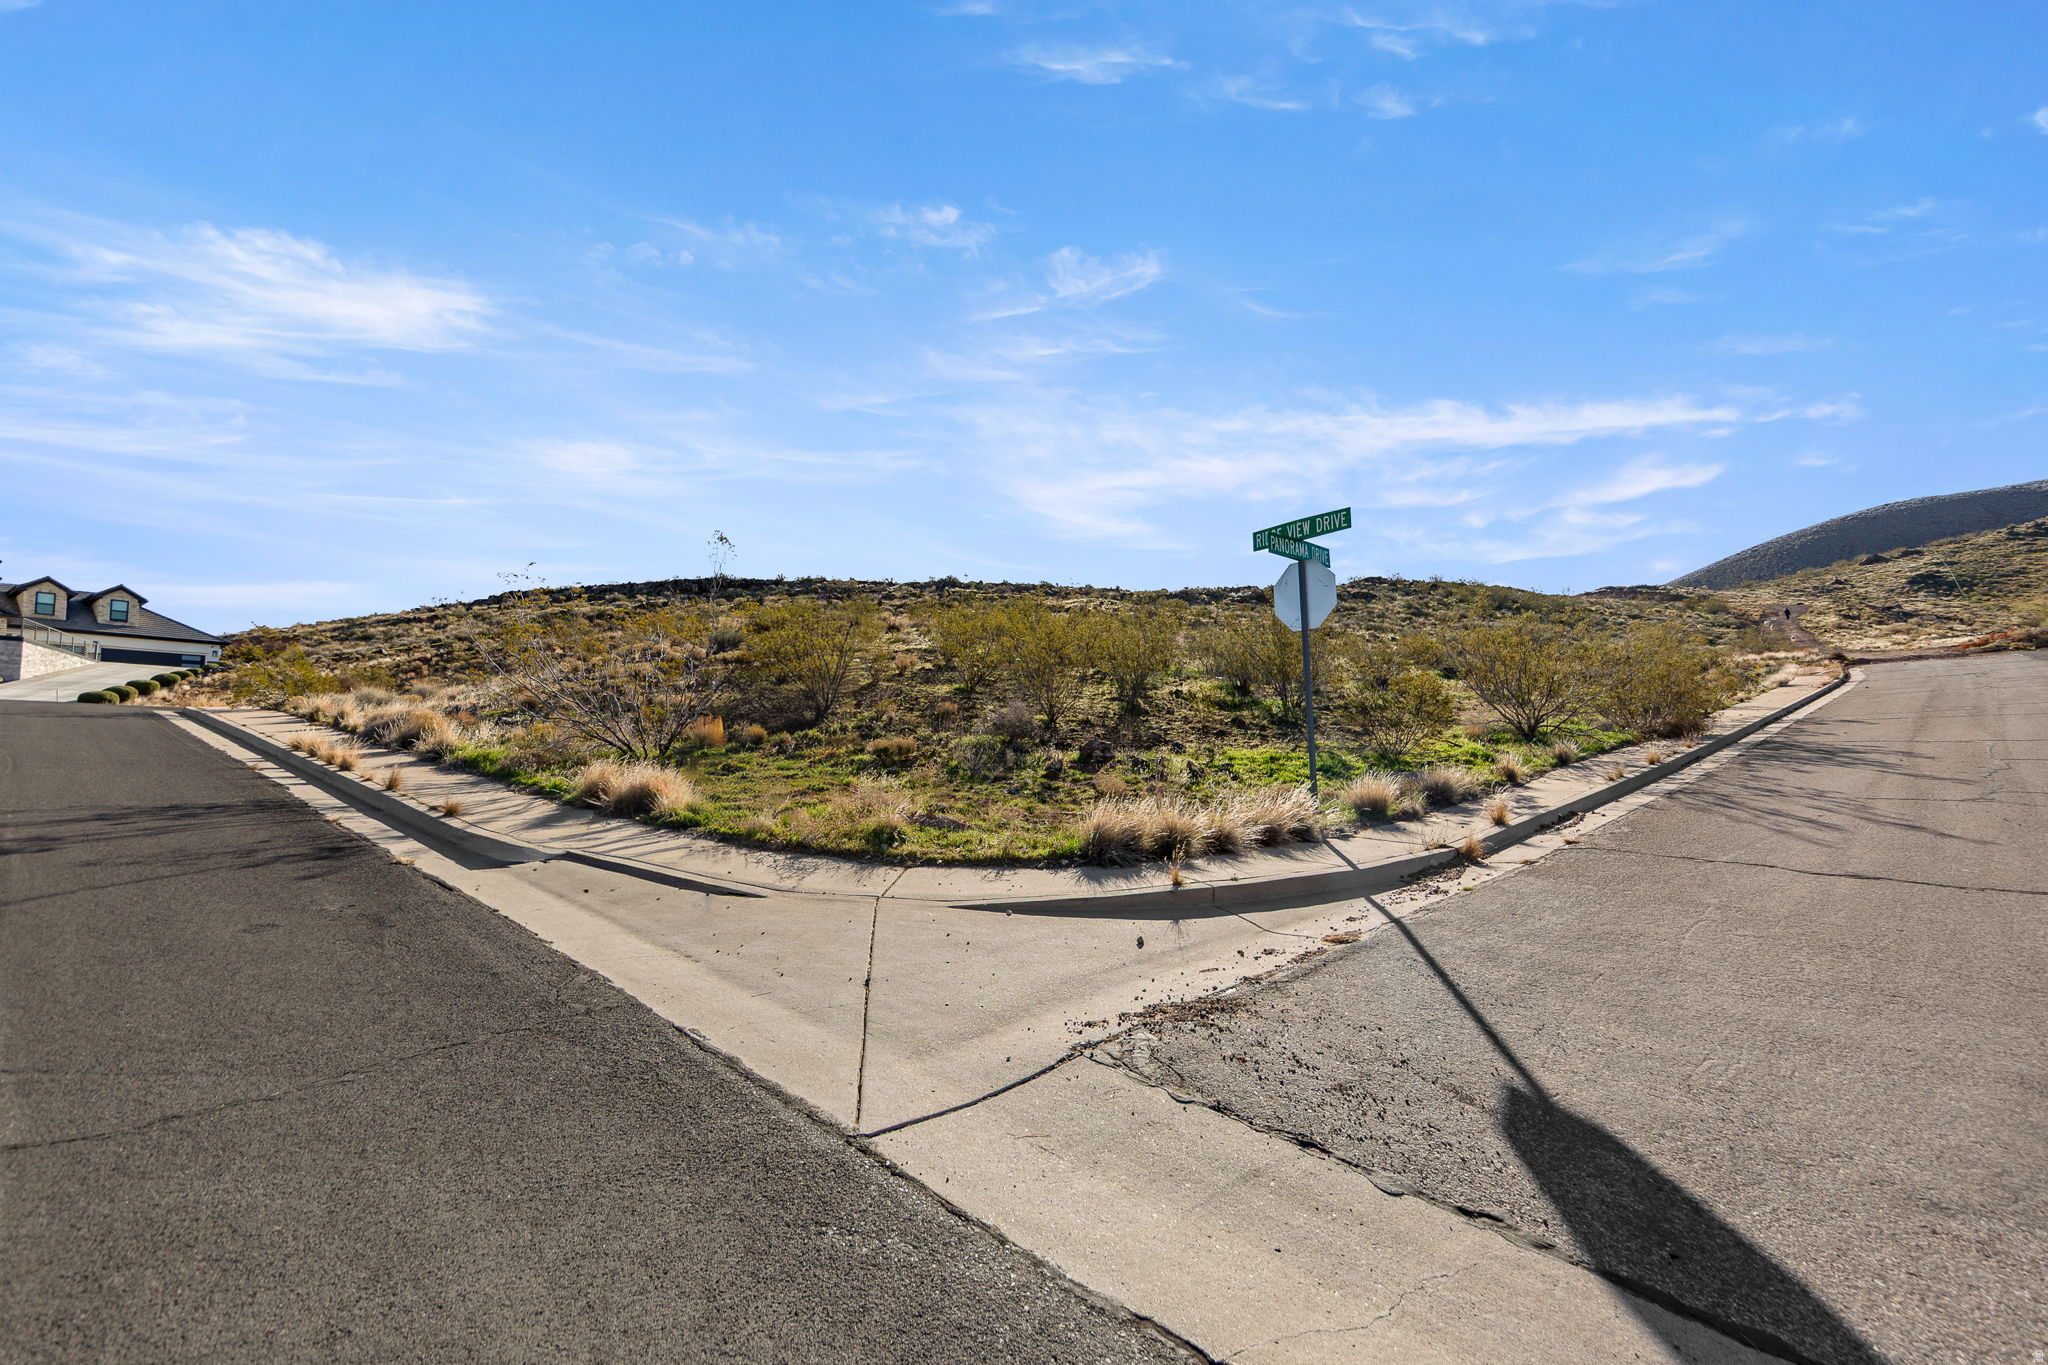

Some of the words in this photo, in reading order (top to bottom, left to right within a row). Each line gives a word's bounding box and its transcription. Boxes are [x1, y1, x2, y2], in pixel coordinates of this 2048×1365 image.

[1287, 520, 1310, 538] VIEW
[1316, 511, 1347, 533] DRIVE
[1270, 535, 1309, 559] PANORAMA
[1311, 546, 1329, 565] DRIVE
